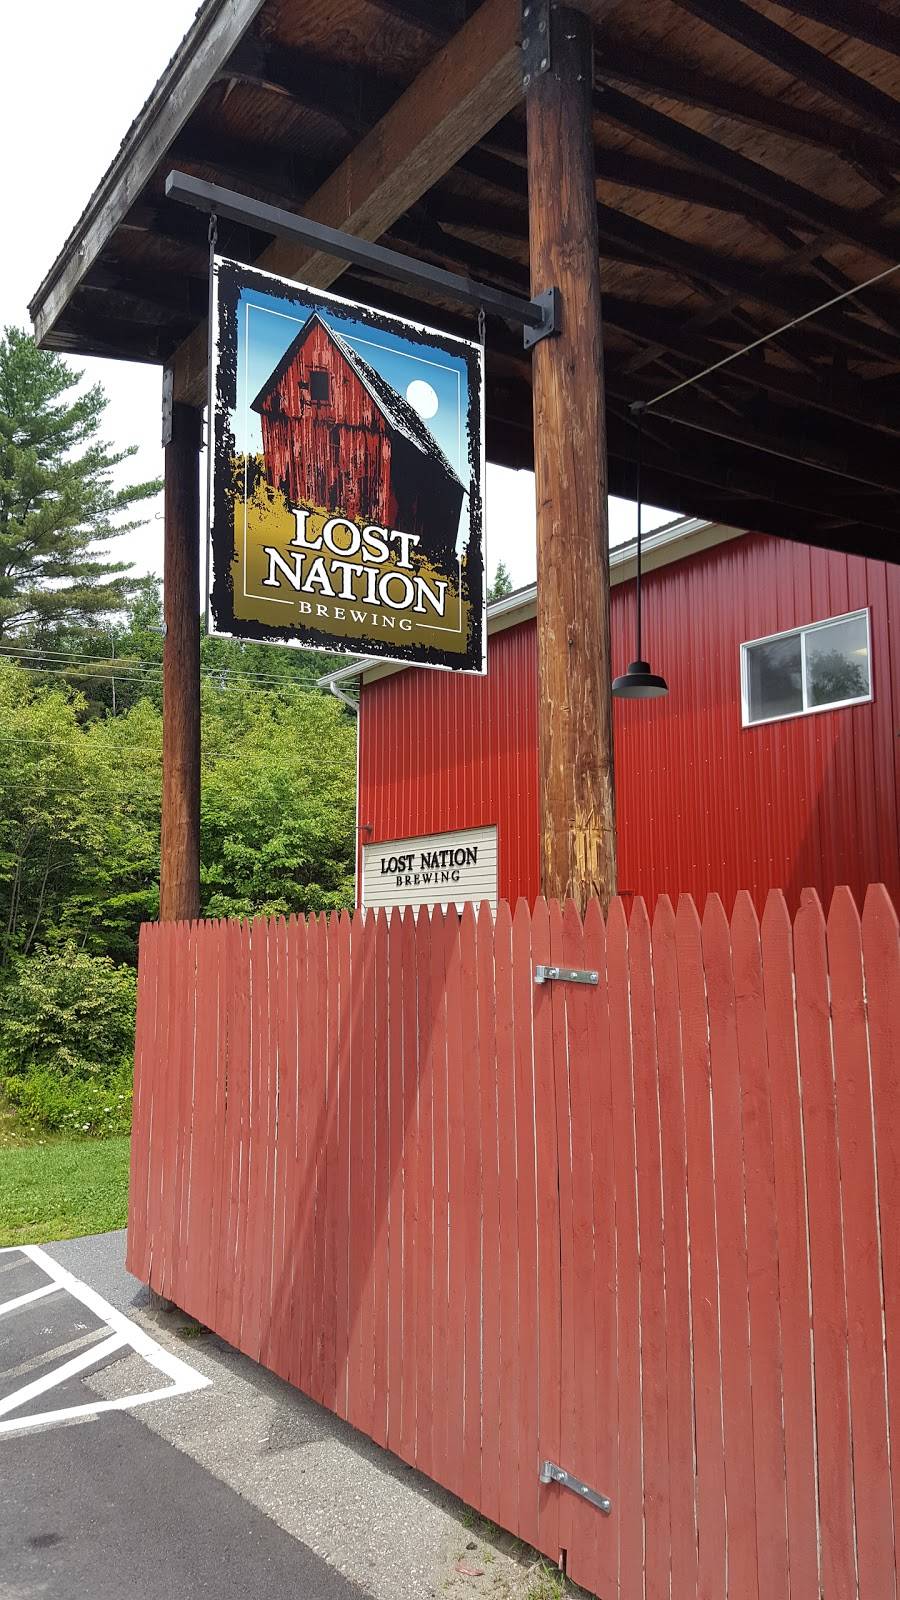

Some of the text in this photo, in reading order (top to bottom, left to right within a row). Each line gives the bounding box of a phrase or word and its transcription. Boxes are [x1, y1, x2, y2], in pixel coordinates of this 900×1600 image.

[291, 508, 420, 569] LOST
[263, 547, 448, 617] NATION
[299, 601, 413, 631] BREWING
[380, 847, 478, 874] LOST NATION
[396, 870, 460, 887] BREWING
